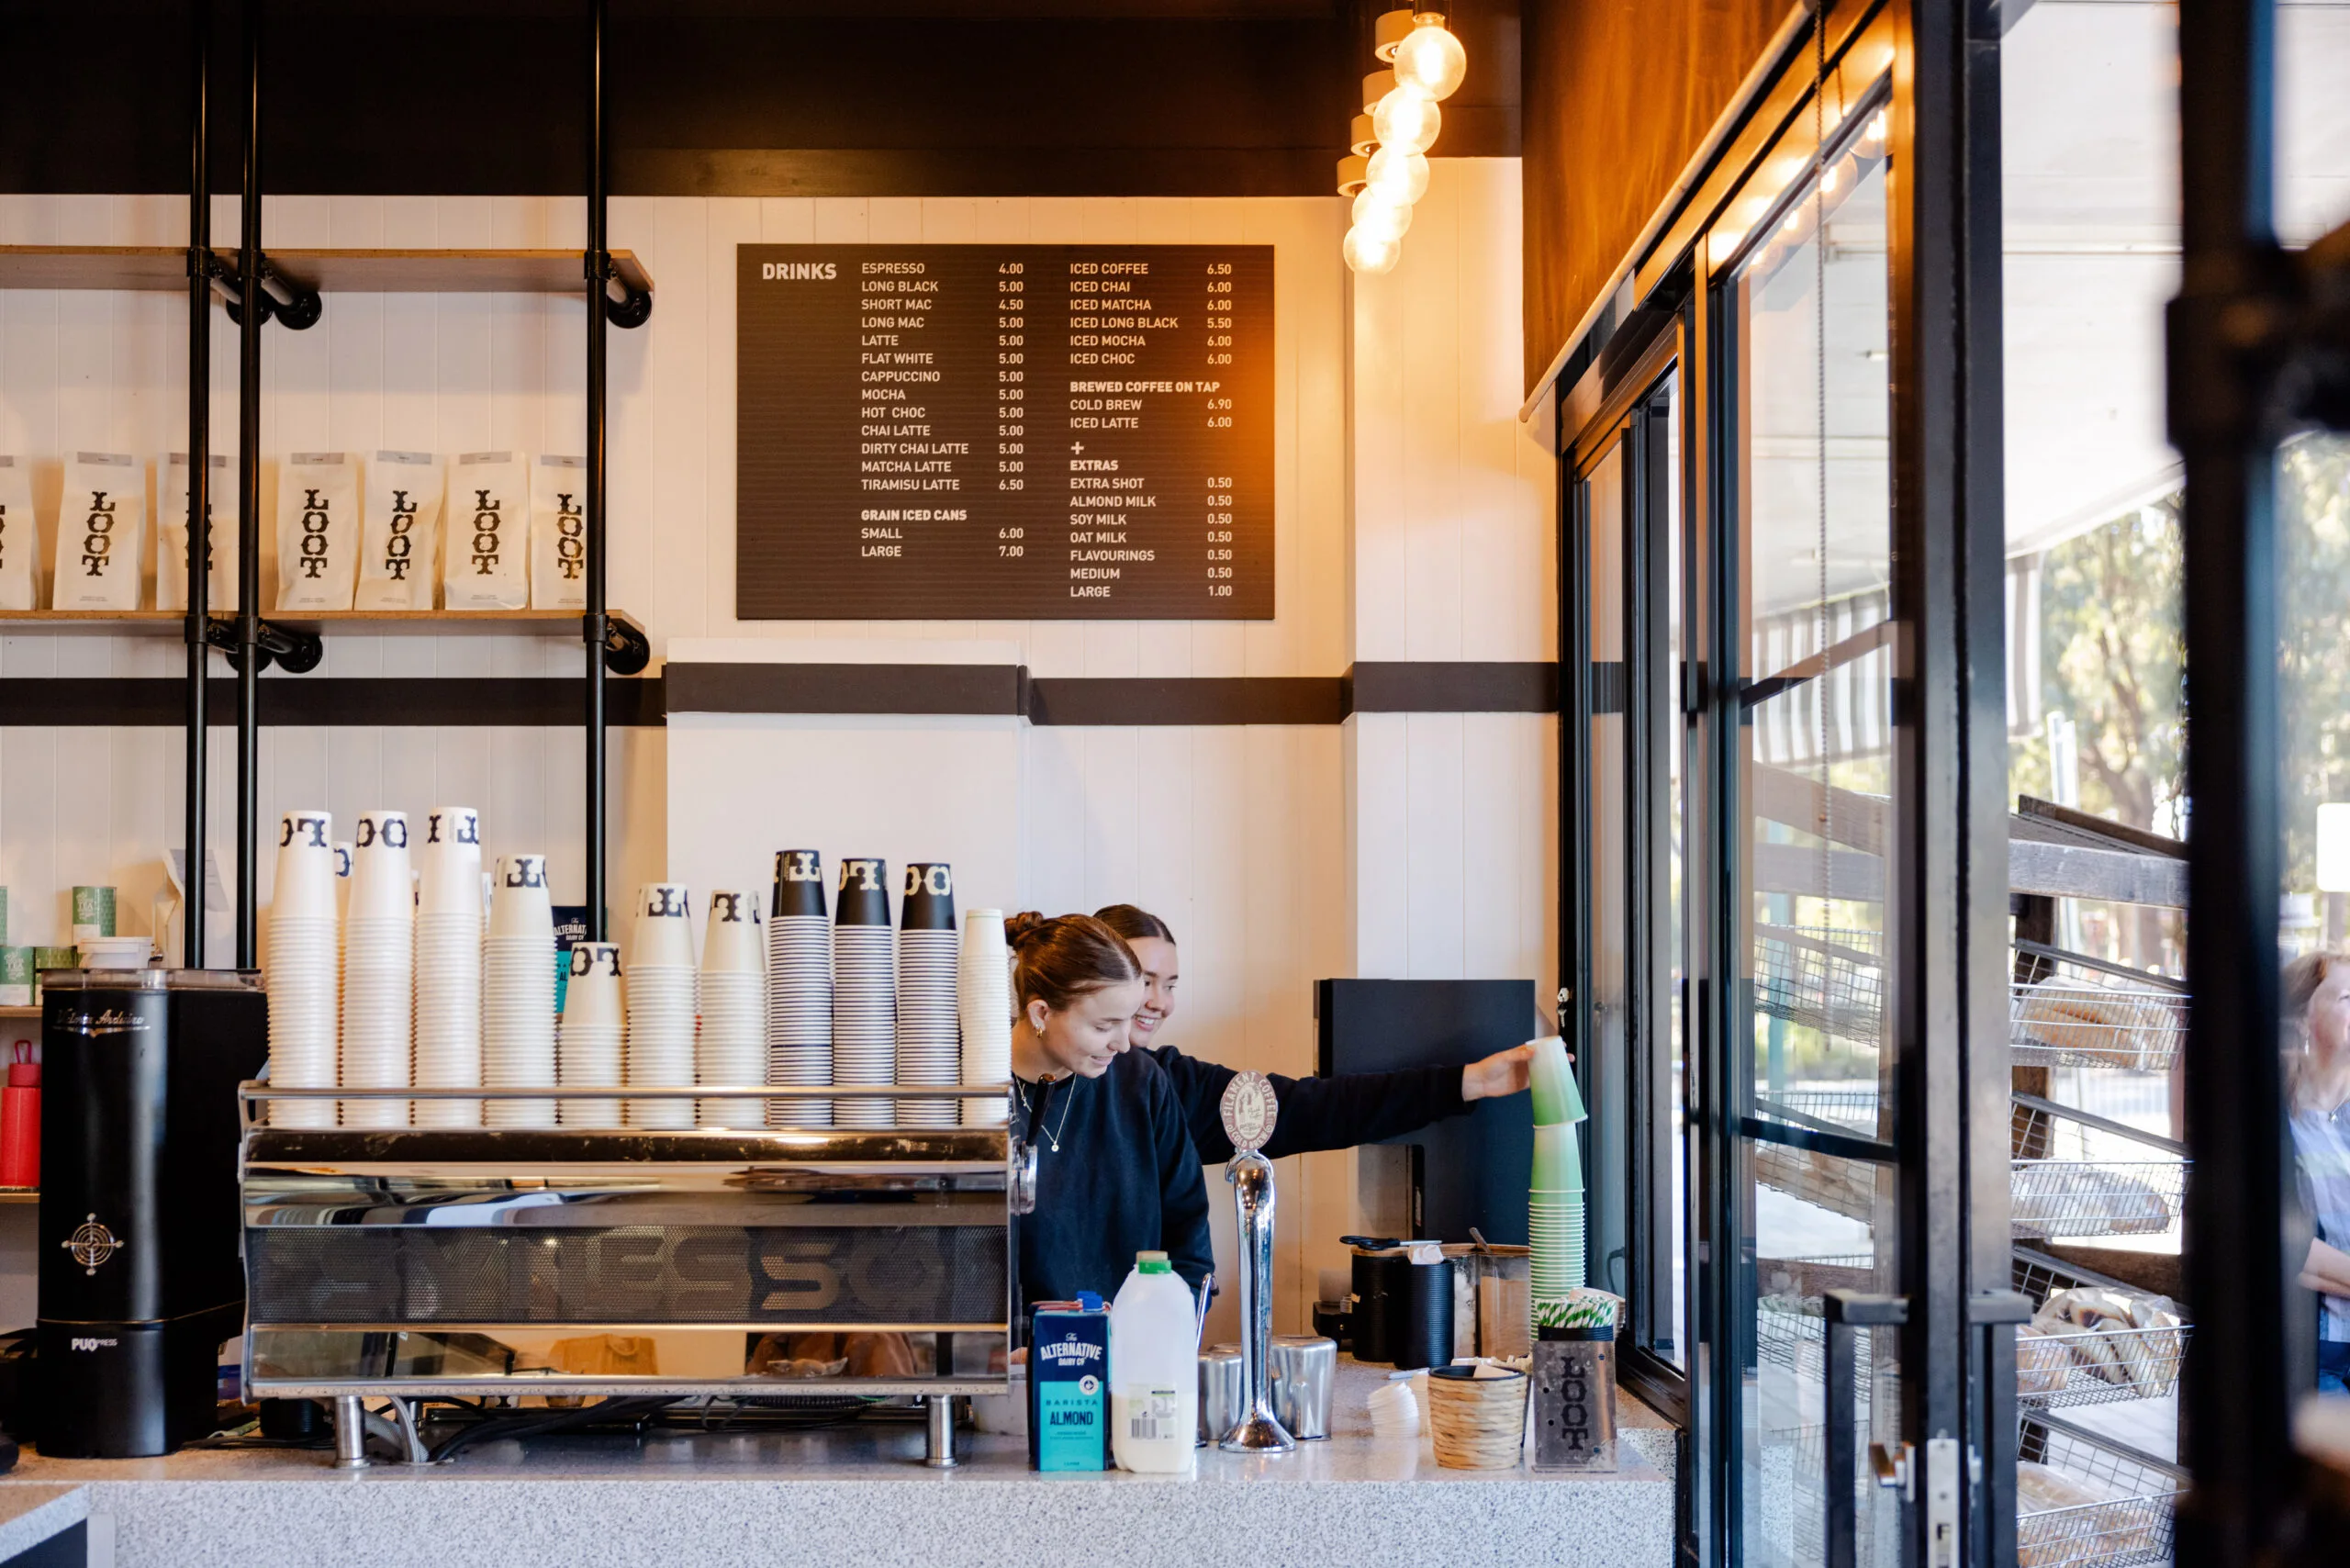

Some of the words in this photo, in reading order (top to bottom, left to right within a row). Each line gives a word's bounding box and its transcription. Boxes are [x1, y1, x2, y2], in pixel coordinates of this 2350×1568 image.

[762, 263, 837, 280] DRINKS
[861, 262, 925, 274] ESPRESSO
[998, 263, 1024, 274] 4.00
[1069, 263, 1099, 274] ICED
[1101, 263, 1149, 274] COFFEE
[1206, 263, 1232, 275] 6.50
[861, 280, 895, 292] LONG
[898, 280, 939, 293] BLACK
[999, 280, 1024, 293] 5.00
[1069, 281, 1099, 293] ICED
[1101, 281, 1131, 293] CHAI
[1206, 281, 1232, 293] 6.00
[861, 298, 903, 310] SHORT
[905, 298, 933, 310] MAC
[998, 298, 1024, 311] 4.50
[1069, 298, 1099, 311] ICED
[1101, 298, 1152, 311] MATCHA
[1206, 299, 1232, 311] 6.00
[861, 316, 895, 329] LONG
[897, 316, 925, 329] MAC
[999, 316, 1024, 329] 5.00
[1069, 317, 1099, 329] ICED
[1101, 317, 1135, 329] LONG
[1137, 317, 1179, 329] BLACK
[1206, 317, 1232, 329] 5.50
[861, 334, 900, 346] LATTE
[999, 334, 1024, 347] 5.00
[1069, 334, 1099, 347] ICED
[1101, 334, 1147, 347] MOCHA
[1206, 335, 1232, 347] 6.00
[861, 353, 892, 364] FLAT
[893, 353, 934, 364] WHITE
[998, 353, 1024, 364] 5.00
[1069, 353, 1099, 364] ICED
[1101, 353, 1136, 364] CHOC
[1206, 353, 1232, 365] 6.00
[861, 370, 941, 383] CAPPUCCINO
[999, 370, 1024, 383] 5.00
[1069, 380, 1124, 393] BREWED
[1125, 381, 1174, 393] COFFEE
[1175, 381, 1193, 393] ON
[1194, 381, 1221, 393] TAP
[861, 388, 907, 400] MOCHA
[999, 388, 1024, 401] 5.00
[1069, 398, 1103, 411] COLD
[1105, 398, 1143, 411] BREW
[1206, 398, 1232, 410] 6.90
[861, 406, 887, 419] HOT
[891, 407, 926, 419] CHOC
[999, 407, 1024, 419] 5.00
[1069, 417, 1100, 429] ICED
[1101, 417, 1139, 429] LATTE
[1206, 416, 1233, 428] 6.00
[861, 424, 890, 437] CHAI
[893, 424, 931, 437] LATTE
[998, 424, 1024, 437] 5.00
[861, 442, 898, 454] DIRTY
[899, 442, 929, 454] CHAI
[931, 442, 969, 455] LATTE
[999, 442, 1024, 455] 5.00
[861, 460, 912, 473] MATCHA
[914, 460, 952, 473] LATTE
[998, 460, 1024, 473] 5.00
[1069, 459, 1119, 472] EXTRAS
[860, 478, 921, 491] TIRAMISU
[923, 478, 960, 491] LATTE
[998, 478, 1024, 491] 6.50
[1069, 477, 1111, 489] EXTRA
[1112, 476, 1146, 489] SHOT
[1206, 476, 1233, 488] 0.50
[1069, 495, 1124, 508] ALMOND
[1125, 495, 1157, 508] MILK
[1206, 494, 1233, 507] 0.50
[860, 509, 901, 521] GRAIN
[901, 509, 932, 521] ICED
[933, 509, 968, 521] CANS
[1069, 513, 1094, 526] SOY
[1096, 513, 1127, 526] MILK
[1207, 512, 1233, 525] 0.50
[82, 491, 116, 577] LOOT
[300, 489, 330, 578] LOOT
[386, 490, 418, 580] LOOT
[472, 489, 501, 575] LOOT
[556, 494, 584, 579] LOOT
[860, 527, 903, 540] SMALL
[998, 527, 1024, 540] 6.00
[1069, 532, 1094, 543] OAT
[1095, 532, 1127, 543] MILK
[1207, 531, 1233, 543] 0.50
[861, 545, 902, 557] LARGE
[998, 544, 1024, 557] 7.00
[1069, 549, 1156, 562] FLAVOURINGS
[1207, 548, 1233, 561] 0.50
[1069, 567, 1121, 580] MEDIUM
[1207, 566, 1233, 579] 0.50
[1069, 586, 1112, 598] LARGE
[1207, 585, 1233, 597] 1.00
[554, 924, 587, 936] ALTERNAT
[1224, 1071, 1257, 1116] FILAMENT
[1040, 1341, 1102, 1361] ALTERNATIVE
[1058, 1358, 1075, 1366] DAIRY
[1046, 1398, 1099, 1406] BARISTA
[1561, 1356, 1589, 1450] LOOT
[1049, 1411, 1094, 1426] ALMOND
